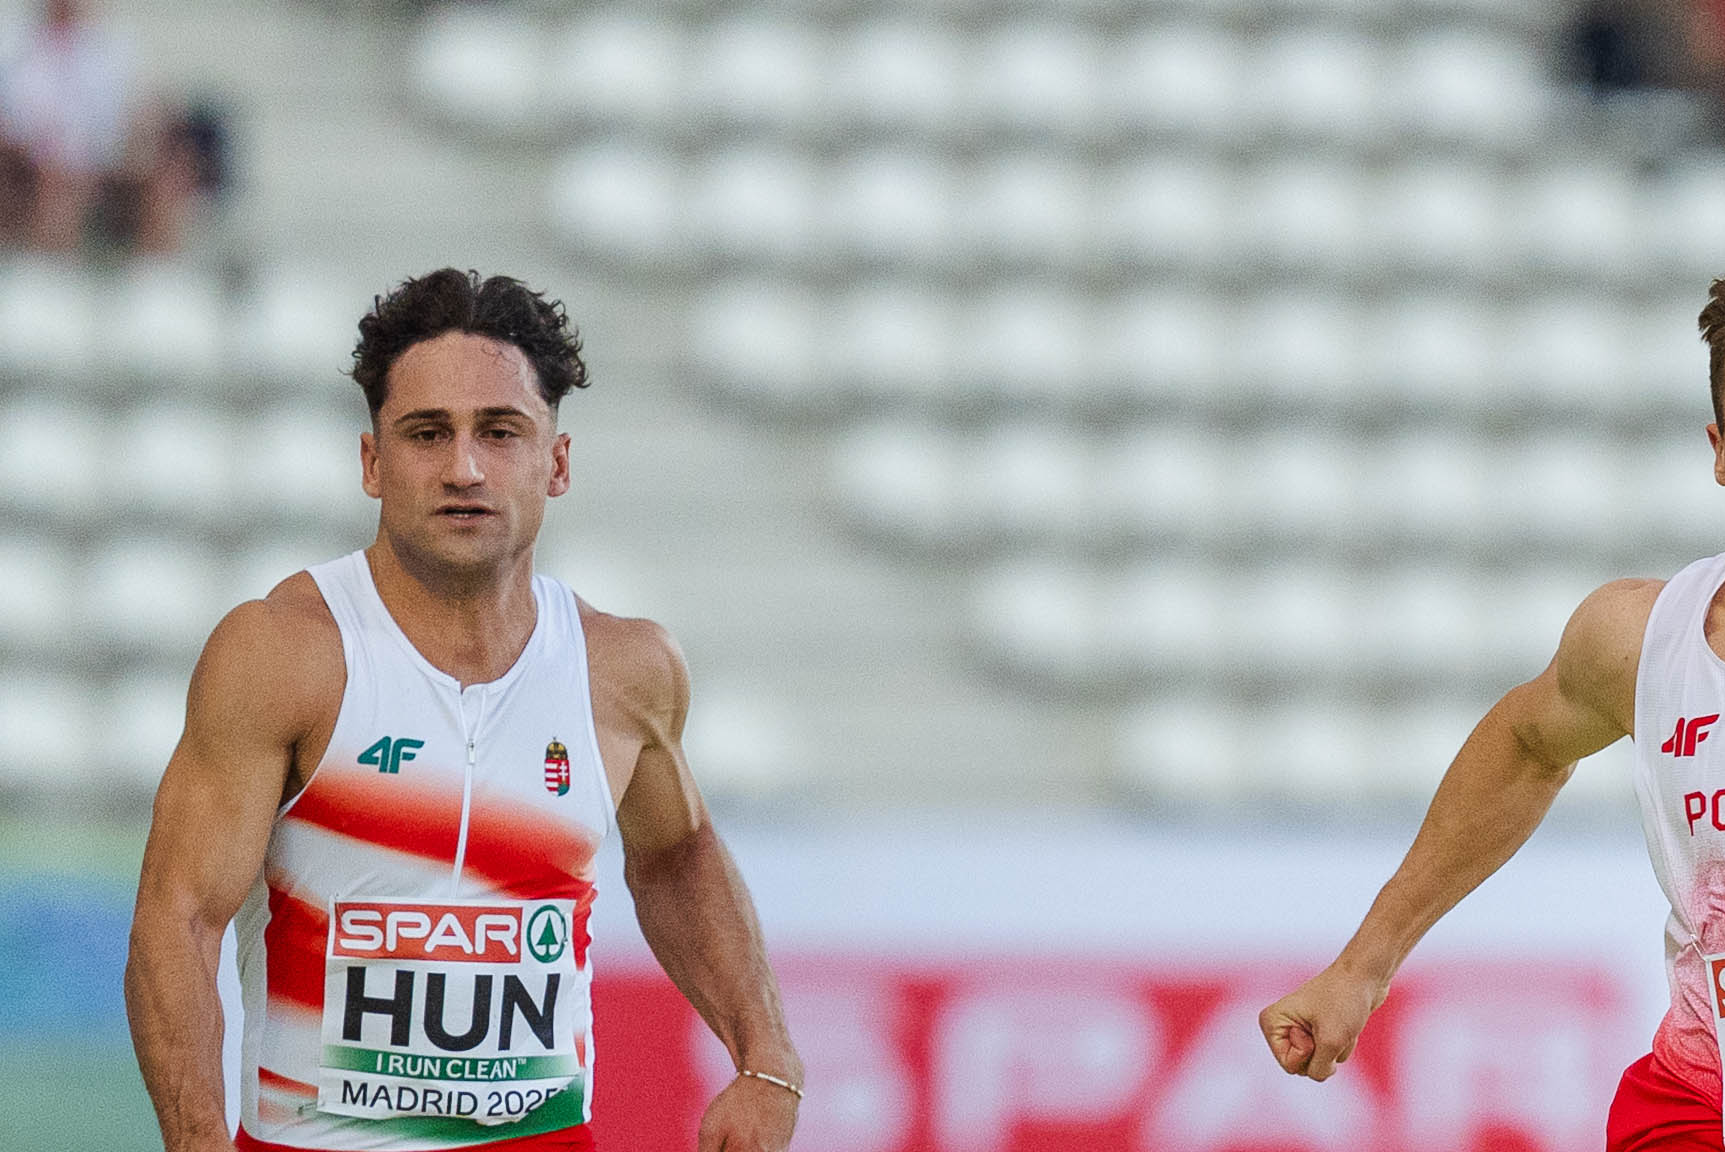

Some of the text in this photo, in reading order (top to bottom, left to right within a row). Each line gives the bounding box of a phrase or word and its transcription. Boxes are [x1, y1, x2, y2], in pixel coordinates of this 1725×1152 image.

[357, 736, 424, 774] 4F
[1661, 713, 1720, 757] 4F
[339, 910, 518, 955] SPAR
[342, 966, 561, 1051] HUN
[376, 1053, 383, 1072] I
[388, 1054, 441, 1078] RUN
[341, 1080, 478, 1117] MADRID
